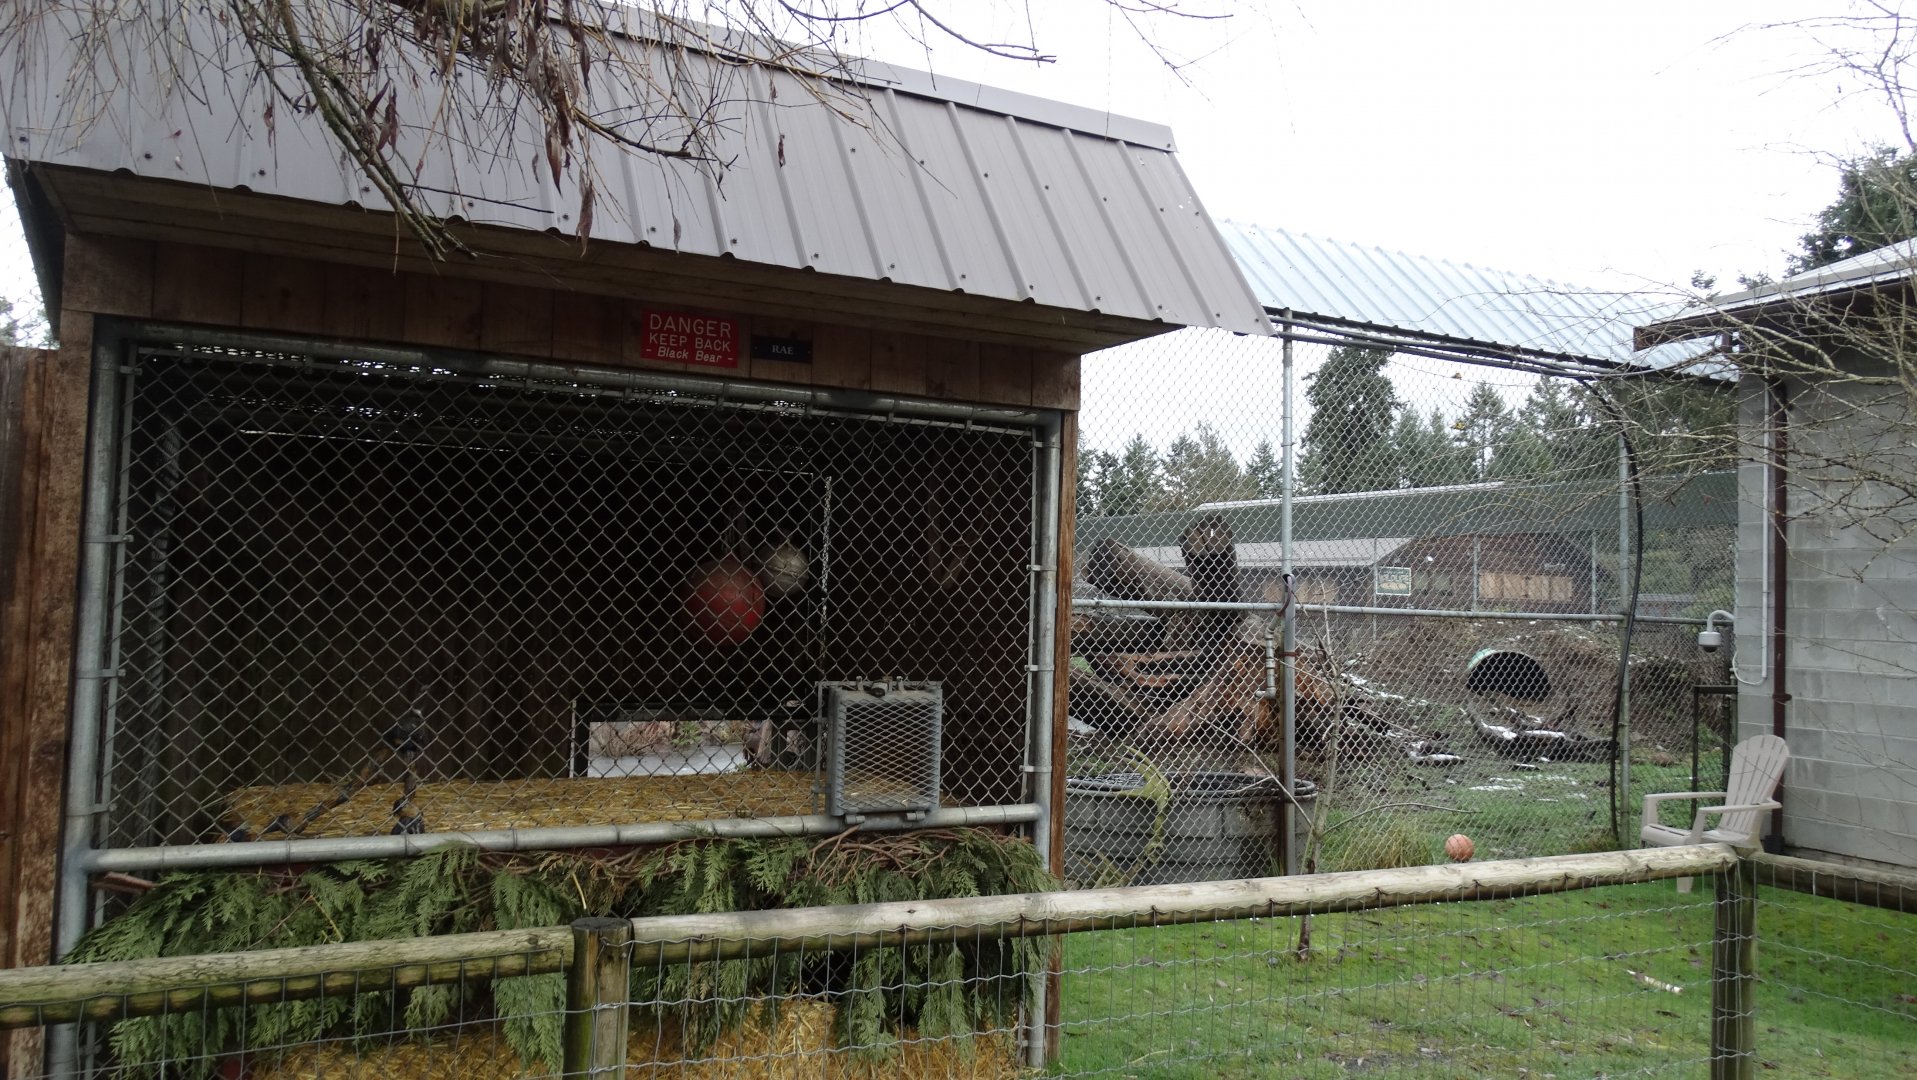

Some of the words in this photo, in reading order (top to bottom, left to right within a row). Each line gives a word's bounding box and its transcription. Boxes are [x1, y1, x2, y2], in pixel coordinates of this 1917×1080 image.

[650, 313, 731, 338] DANGER
[649, 332, 688, 347] KEEP
[695, 337, 731, 352] BACK
[772, 344, 793, 355] RAE
[657, 346, 689, 359] Black
[695, 350, 722, 363] Bear
